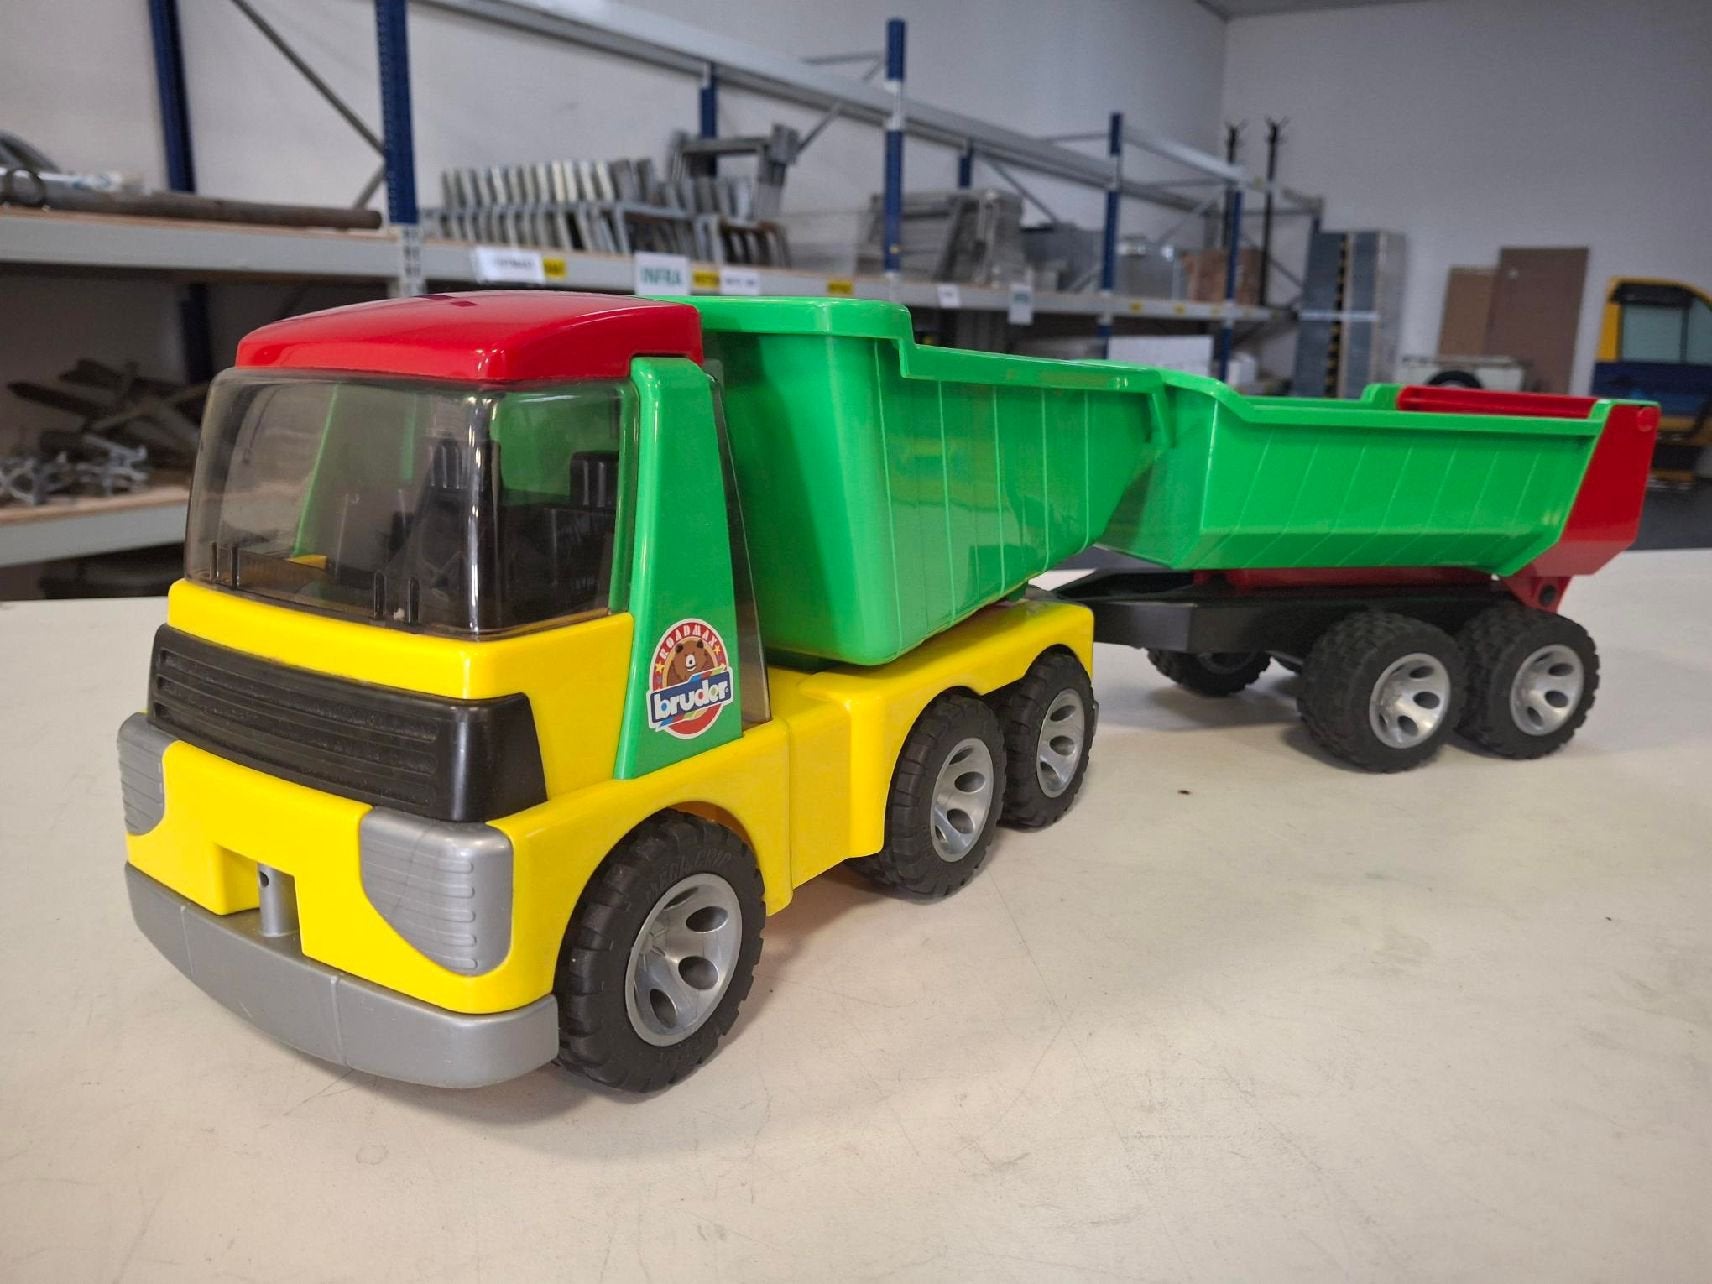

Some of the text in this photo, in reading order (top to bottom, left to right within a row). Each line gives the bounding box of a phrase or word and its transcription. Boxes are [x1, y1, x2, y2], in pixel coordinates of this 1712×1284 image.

[639, 267, 682, 286] INFRA
[659, 624, 717, 660] ROADMAX
[654, 680, 728, 719] bruder
